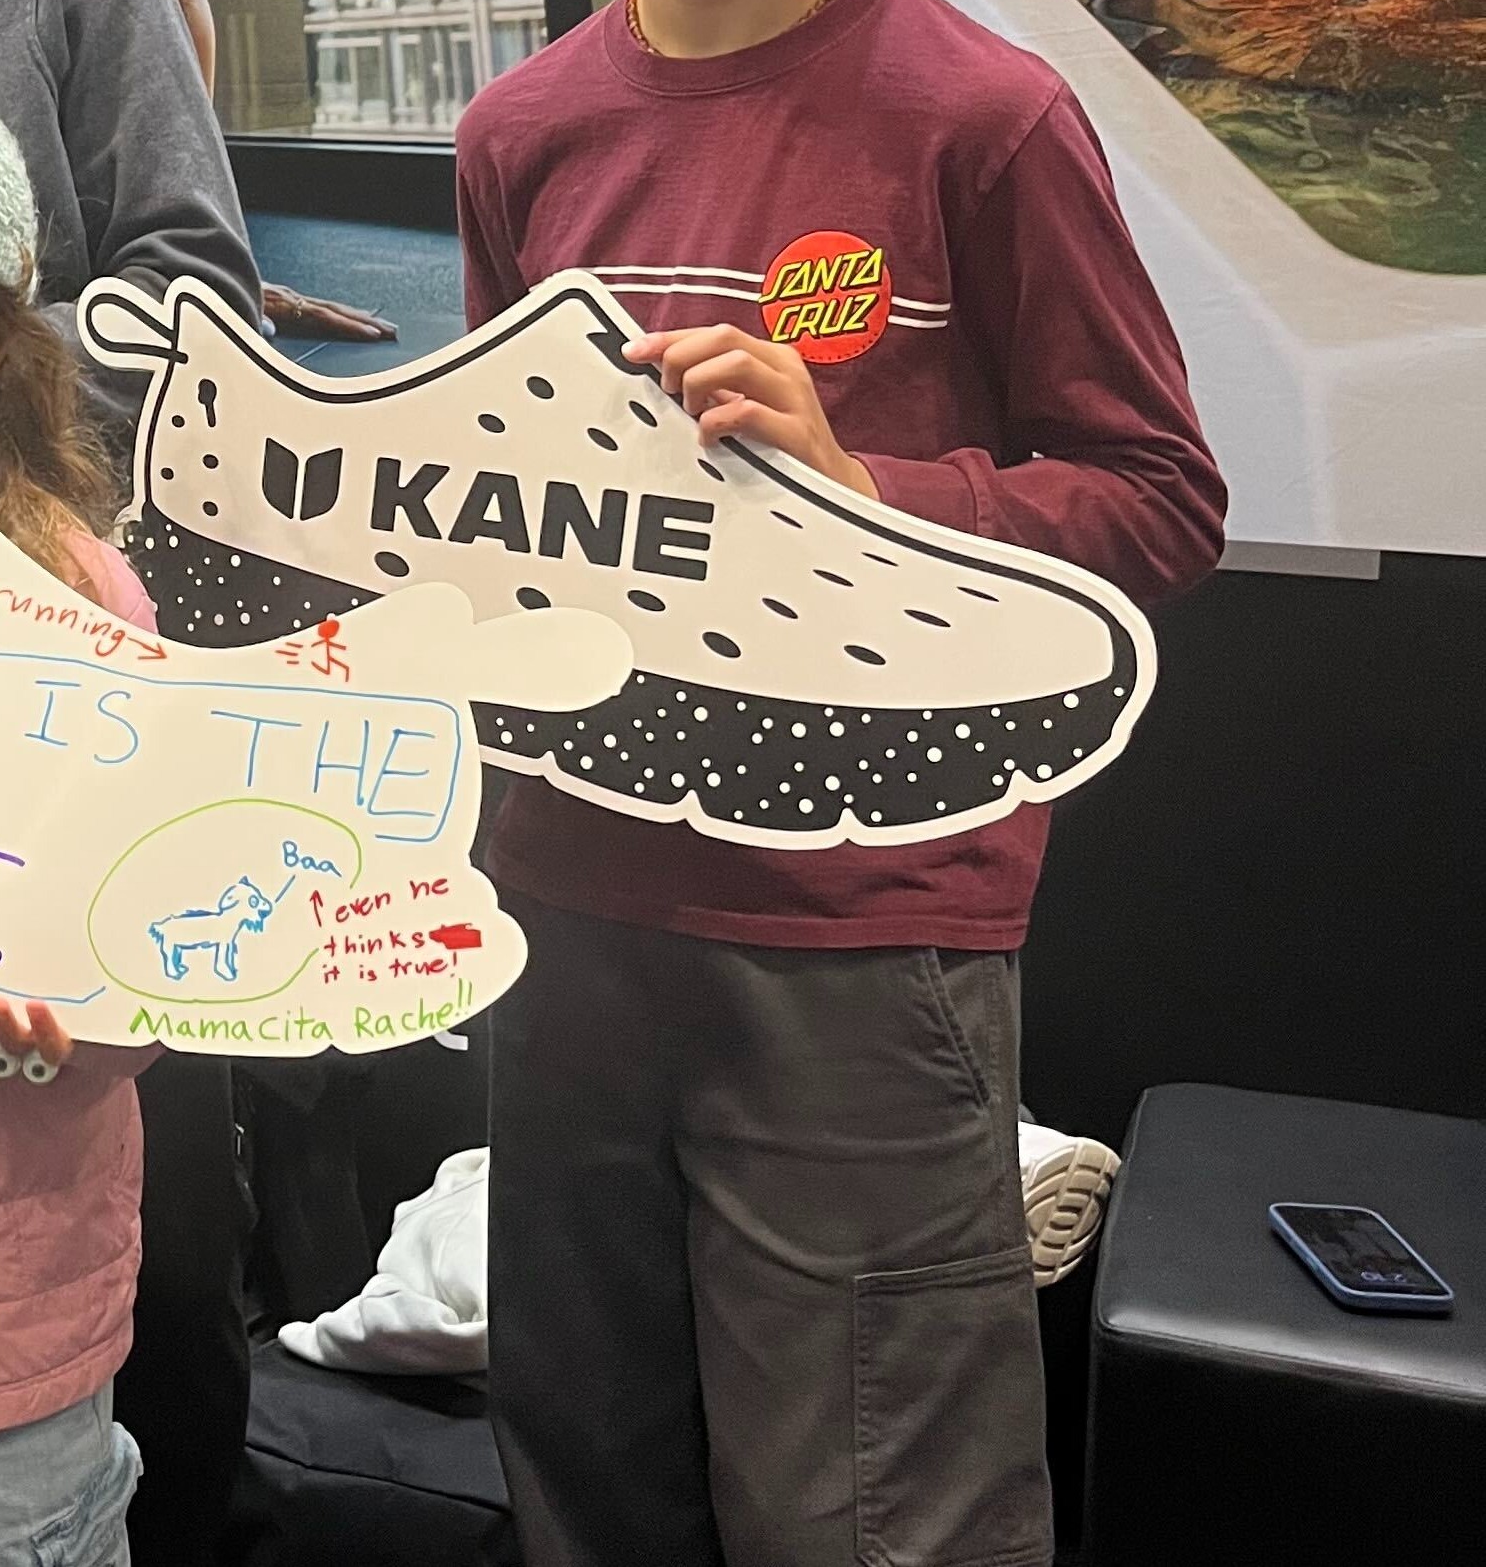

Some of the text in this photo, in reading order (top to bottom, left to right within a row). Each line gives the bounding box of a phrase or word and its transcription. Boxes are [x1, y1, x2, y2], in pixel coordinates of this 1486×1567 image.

[758, 248, 883, 304] SANTA
[771, 292, 879, 343] CRUZ
[370, 456, 715, 582] KANE
[25, 679, 139, 764] IS
[211, 709, 435, 817] THE
[282, 840, 343, 877] Baa
[335, 892, 391, 923] even
[324, 930, 426, 958] thinks
[322, 951, 458, 984] it is true!
